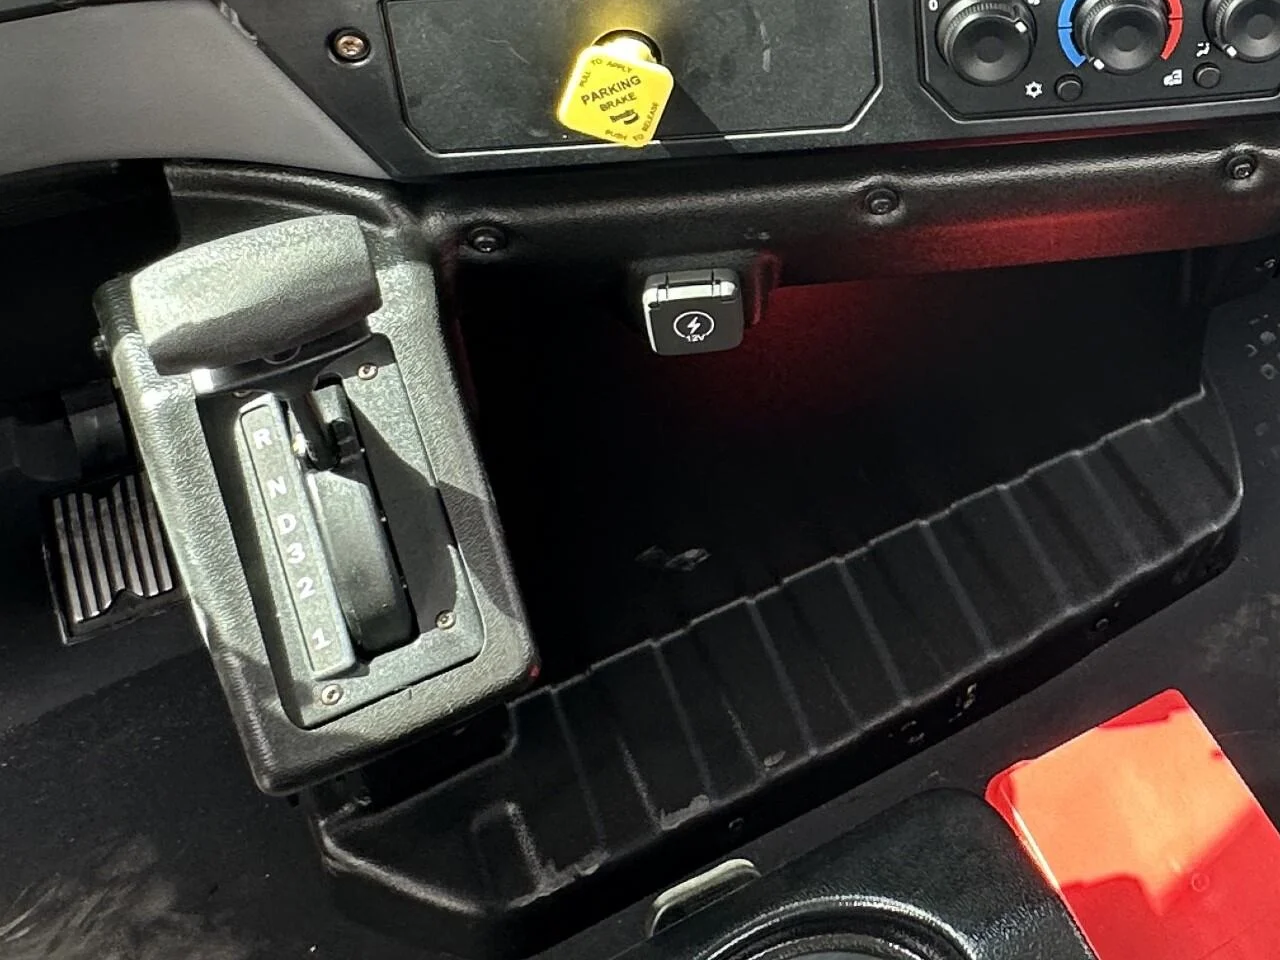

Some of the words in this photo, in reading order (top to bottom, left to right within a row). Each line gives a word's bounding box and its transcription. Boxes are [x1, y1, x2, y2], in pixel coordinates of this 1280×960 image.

[591, 58, 603, 66] TO
[580, 75, 642, 106] PARKING
[599, 91, 638, 112] BRAKE
[632, 132, 645, 141] TO
[641, 101, 660, 132] RELEASE
[686, 334, 705, 342] 12V
[253, 428, 272, 450] R
[267, 475, 288, 499] N
[277, 513, 297, 536] D
[287, 542, 306, 565] 3
[298, 576, 316, 600] 2
[312, 628, 332, 651] 1
